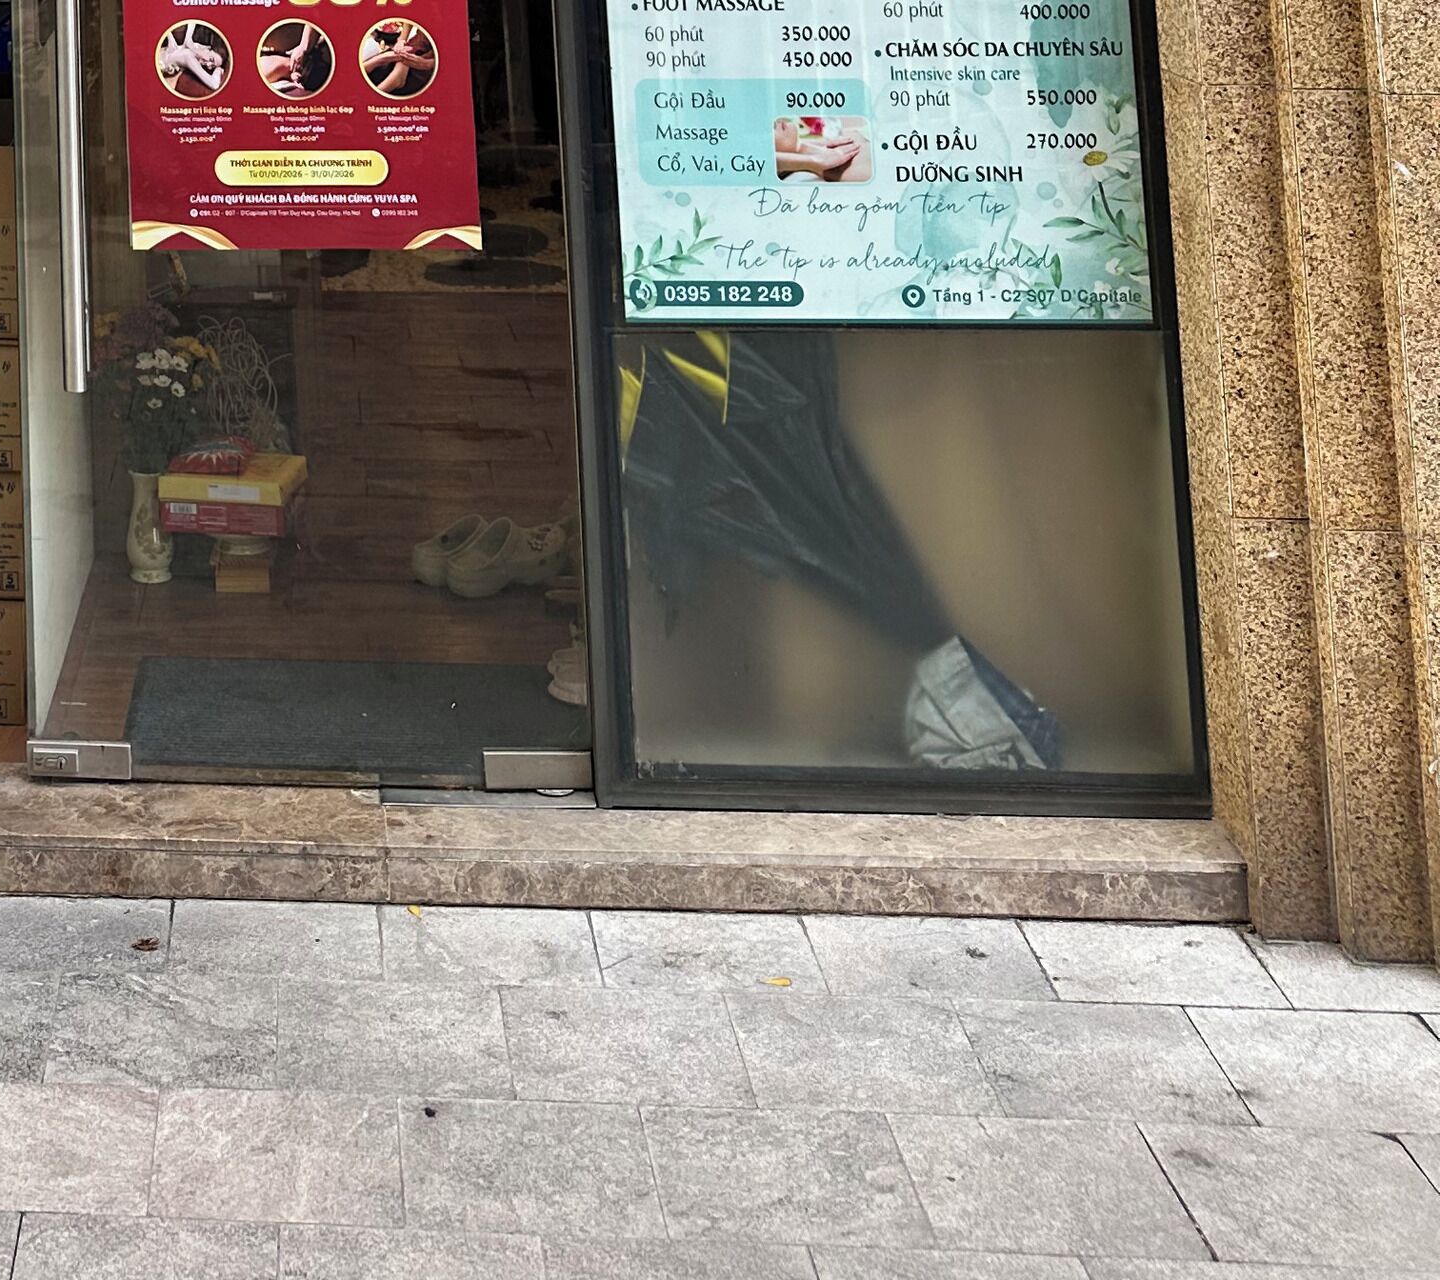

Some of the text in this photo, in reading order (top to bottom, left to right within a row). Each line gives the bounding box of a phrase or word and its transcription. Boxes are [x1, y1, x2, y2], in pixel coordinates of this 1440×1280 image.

[664, 286, 792, 302] 0395 182 248
[1062, 290, 1141, 303] D'Capitale
